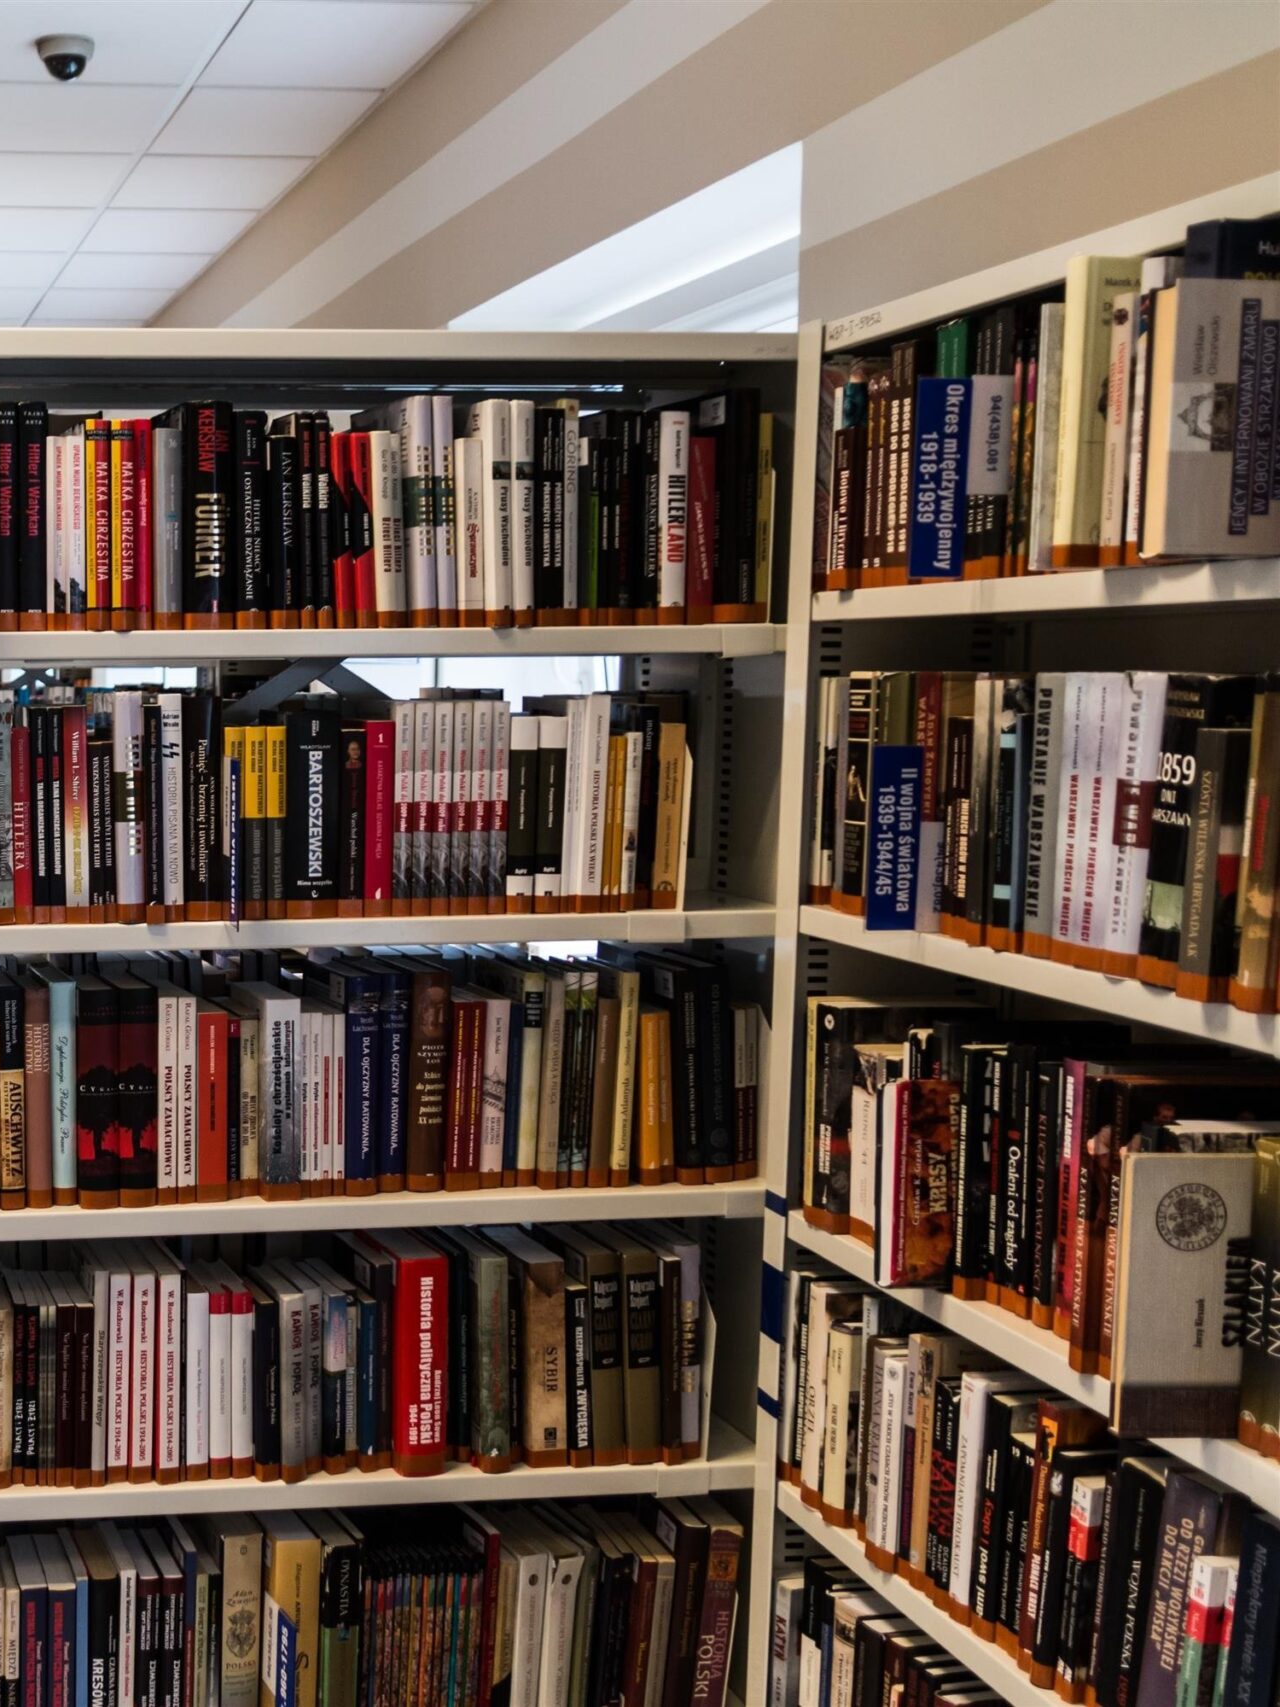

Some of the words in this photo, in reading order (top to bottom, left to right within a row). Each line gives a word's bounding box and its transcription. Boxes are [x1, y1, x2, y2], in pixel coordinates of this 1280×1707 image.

[890, 400, 899, 433] DROGI
[902, 398, 911, 431] DROGI
[945, 384, 965, 434] Okres
[199, 409, 215, 472] KERSHAW
[216, 430, 229, 451] IAN
[890, 436, 899, 450] DO
[901, 434, 911, 448] DO
[986, 395, 1003, 472] 94(438).081
[25, 443, 40, 474] Hitler
[73, 445, 82, 467] UPADEK
[282, 452, 293, 476] IAN
[381, 449, 389, 473] Guido
[917, 431, 939, 523] 1918-1939
[73, 470, 82, 486] MURU
[96, 461, 108, 501] MATKA
[122, 461, 133, 501] MATKA
[302, 474, 313, 509] Walkiria
[318, 474, 329, 509] Walkiria
[381, 477, 389, 499] Knopp
[499, 486, 509, 512] Prusy
[887, 453, 899, 527] NIEPODLEGŁEJ
[899, 452, 910, 524] NIEPODLEGŁEJ
[25, 486, 40, 536] Watykan
[73, 488, 82, 530] BERLIŃSKIEGO
[244, 479, 253, 534] OSTATECZNE
[282, 482, 293, 547] KERSHAW
[522, 487, 532, 513] Prusy
[647, 474, 658, 532] WSPÓLNICY
[667, 475, 685, 563] HITLERLAND
[934, 438, 960, 570] międzywojenny
[96, 510, 108, 581] CHRZESTNA
[122, 510, 133, 581] CHRZESTNA
[195, 493, 230, 578] FÜHRER
[382, 517, 391, 542] Dzieci
[501, 515, 510, 566] Wschodnie
[524, 516, 533, 567] Wschodnie
[887, 530, 896, 553] 1918
[898, 528, 907, 552] 1918
[244, 537, 253, 600] ROZWIĄZANIE
[383, 545, 392, 573] Hitlera
[647, 535, 658, 578] HITLERA
[71, 731, 80, 763] William
[196, 739, 208, 773] Pamięć
[1033, 688, 1053, 786] POWSTANIE
[71, 777, 80, 800] Shirer
[167, 767, 179, 807] HISTORIA
[902, 768, 917, 778] II
[1156, 752, 1196, 786] 1859
[196, 784, 208, 823] brzemię
[592, 771, 601, 811] HISTORIA
[897, 784, 914, 831] wojna
[1066, 774, 1079, 839] WARSZAWSKI
[1089, 776, 1103, 843] WARSZAWSKI
[1198, 770, 1212, 814] SZÓSTA
[167, 809, 179, 840] PISANA
[308, 751, 323, 877] BARTOSZEWSKI
[590, 813, 598, 841] POLSKI
[14, 802, 24, 870] HITLERA
[167, 843, 179, 854] NA
[196, 830, 208, 882] uwolnienie
[590, 843, 597, 854] XX
[875, 785, 895, 895] 1939-1944/45
[1026, 794, 1045, 918] WARSZAWSKIE
[1193, 819, 1209, 880] WILEŃSKA
[167, 857, 179, 884] NOWO
[588, 856, 596, 882] WIEKU
[895, 836, 916, 912] światowa
[1062, 843, 1076, 892] PIERŚCIEŃ
[1084, 847, 1099, 898] PIERŚCIEŃ
[1059, 896, 1072, 937] ŚMIERCI
[1080, 901, 1097, 943] ŚMIERCI
[1189, 882, 1204, 937] BRYGADA
[1186, 941, 1198, 959] AK
[25, 1030, 33, 1074] POLITYKI
[33, 1026, 42, 1071] HISTORII
[361, 1037, 370, 1054] DLA
[389, 1033, 400, 1051] DLA
[164, 1066, 173, 1104] POLSCY
[183, 1065, 192, 1103] POLSCY
[361, 1057, 370, 1097] OJCZYZNY
[389, 1054, 400, 1094] OJCZYZNY
[1063, 1076, 1075, 1113] ROBERT
[10, 1082, 23, 1177] AUSCHWITZ
[164, 1107, 173, 1177] ZAMACHOWCY
[183, 1106, 192, 1175] ZAMACHOWCY
[361, 1101, 370, 1160] RATOWANIA...
[389, 1097, 400, 1155] RATOWANIA...
[1063, 1114, 1075, 1159] JAROCKI
[927, 1152, 946, 1214] KRESY
[1007, 1145, 1020, 1196] Ocaleni
[1006, 1200, 1019, 1217] od
[1108, 1175, 1121, 1254] KŁAMSTWO
[1003, 1220, 1018, 1271] zagłady
[117, 1289, 123, 1298] W.
[167, 1290, 174, 1299] W.
[419, 1277, 433, 1329] Historia
[1102, 1258, 1119, 1337] KATYŃSKIE
[115, 1301, 123, 1343] Roszkowski
[97, 1330, 105, 1393] Skaryszewskie
[419, 1333, 433, 1400] polityczna
[546, 1347, 557, 1392] SYBIR
[575, 1327, 584, 1386] RZECZPOSPOLITA
[95, 1396, 104, 1427] Wstępy
[166, 1394, 174, 1426] POLSKI
[409, 1404, 417, 1445] 1944-1991
[419, 1403, 433, 1444] Polski
[576, 1389, 588, 1448] ZWYCIĘSKA
[114, 1427, 122, 1461] 1914-2005
[166, 1428, 174, 1462] 1914-2005
[1164, 1525, 1177, 1547] DO
[1180, 1518, 1194, 1541] OD
[1158, 1551, 1174, 1589] AKCJI
[1174, 1542, 1191, 1581] RZEZI
[339, 1559, 350, 1616] DYNASTIA
[1126, 1559, 1142, 1609] WOJNA
[1245, 1544, 1268, 1629] Niepiękny
[1150, 1591, 1168, 1651] „WISŁA”
[1160, 1588, 1185, 1671] WOŁYŃSKIEJ
[8, 1640, 16, 1677] MIĘDZY
[710, 1610, 729, 1679] HISTORIA
[1119, 1615, 1136, 1670] POLSKA
[1240, 1634, 1256, 1675] wiek
[694, 1635, 716, 1698] POLSKI
[1236, 1680, 1252, 1703] XX
